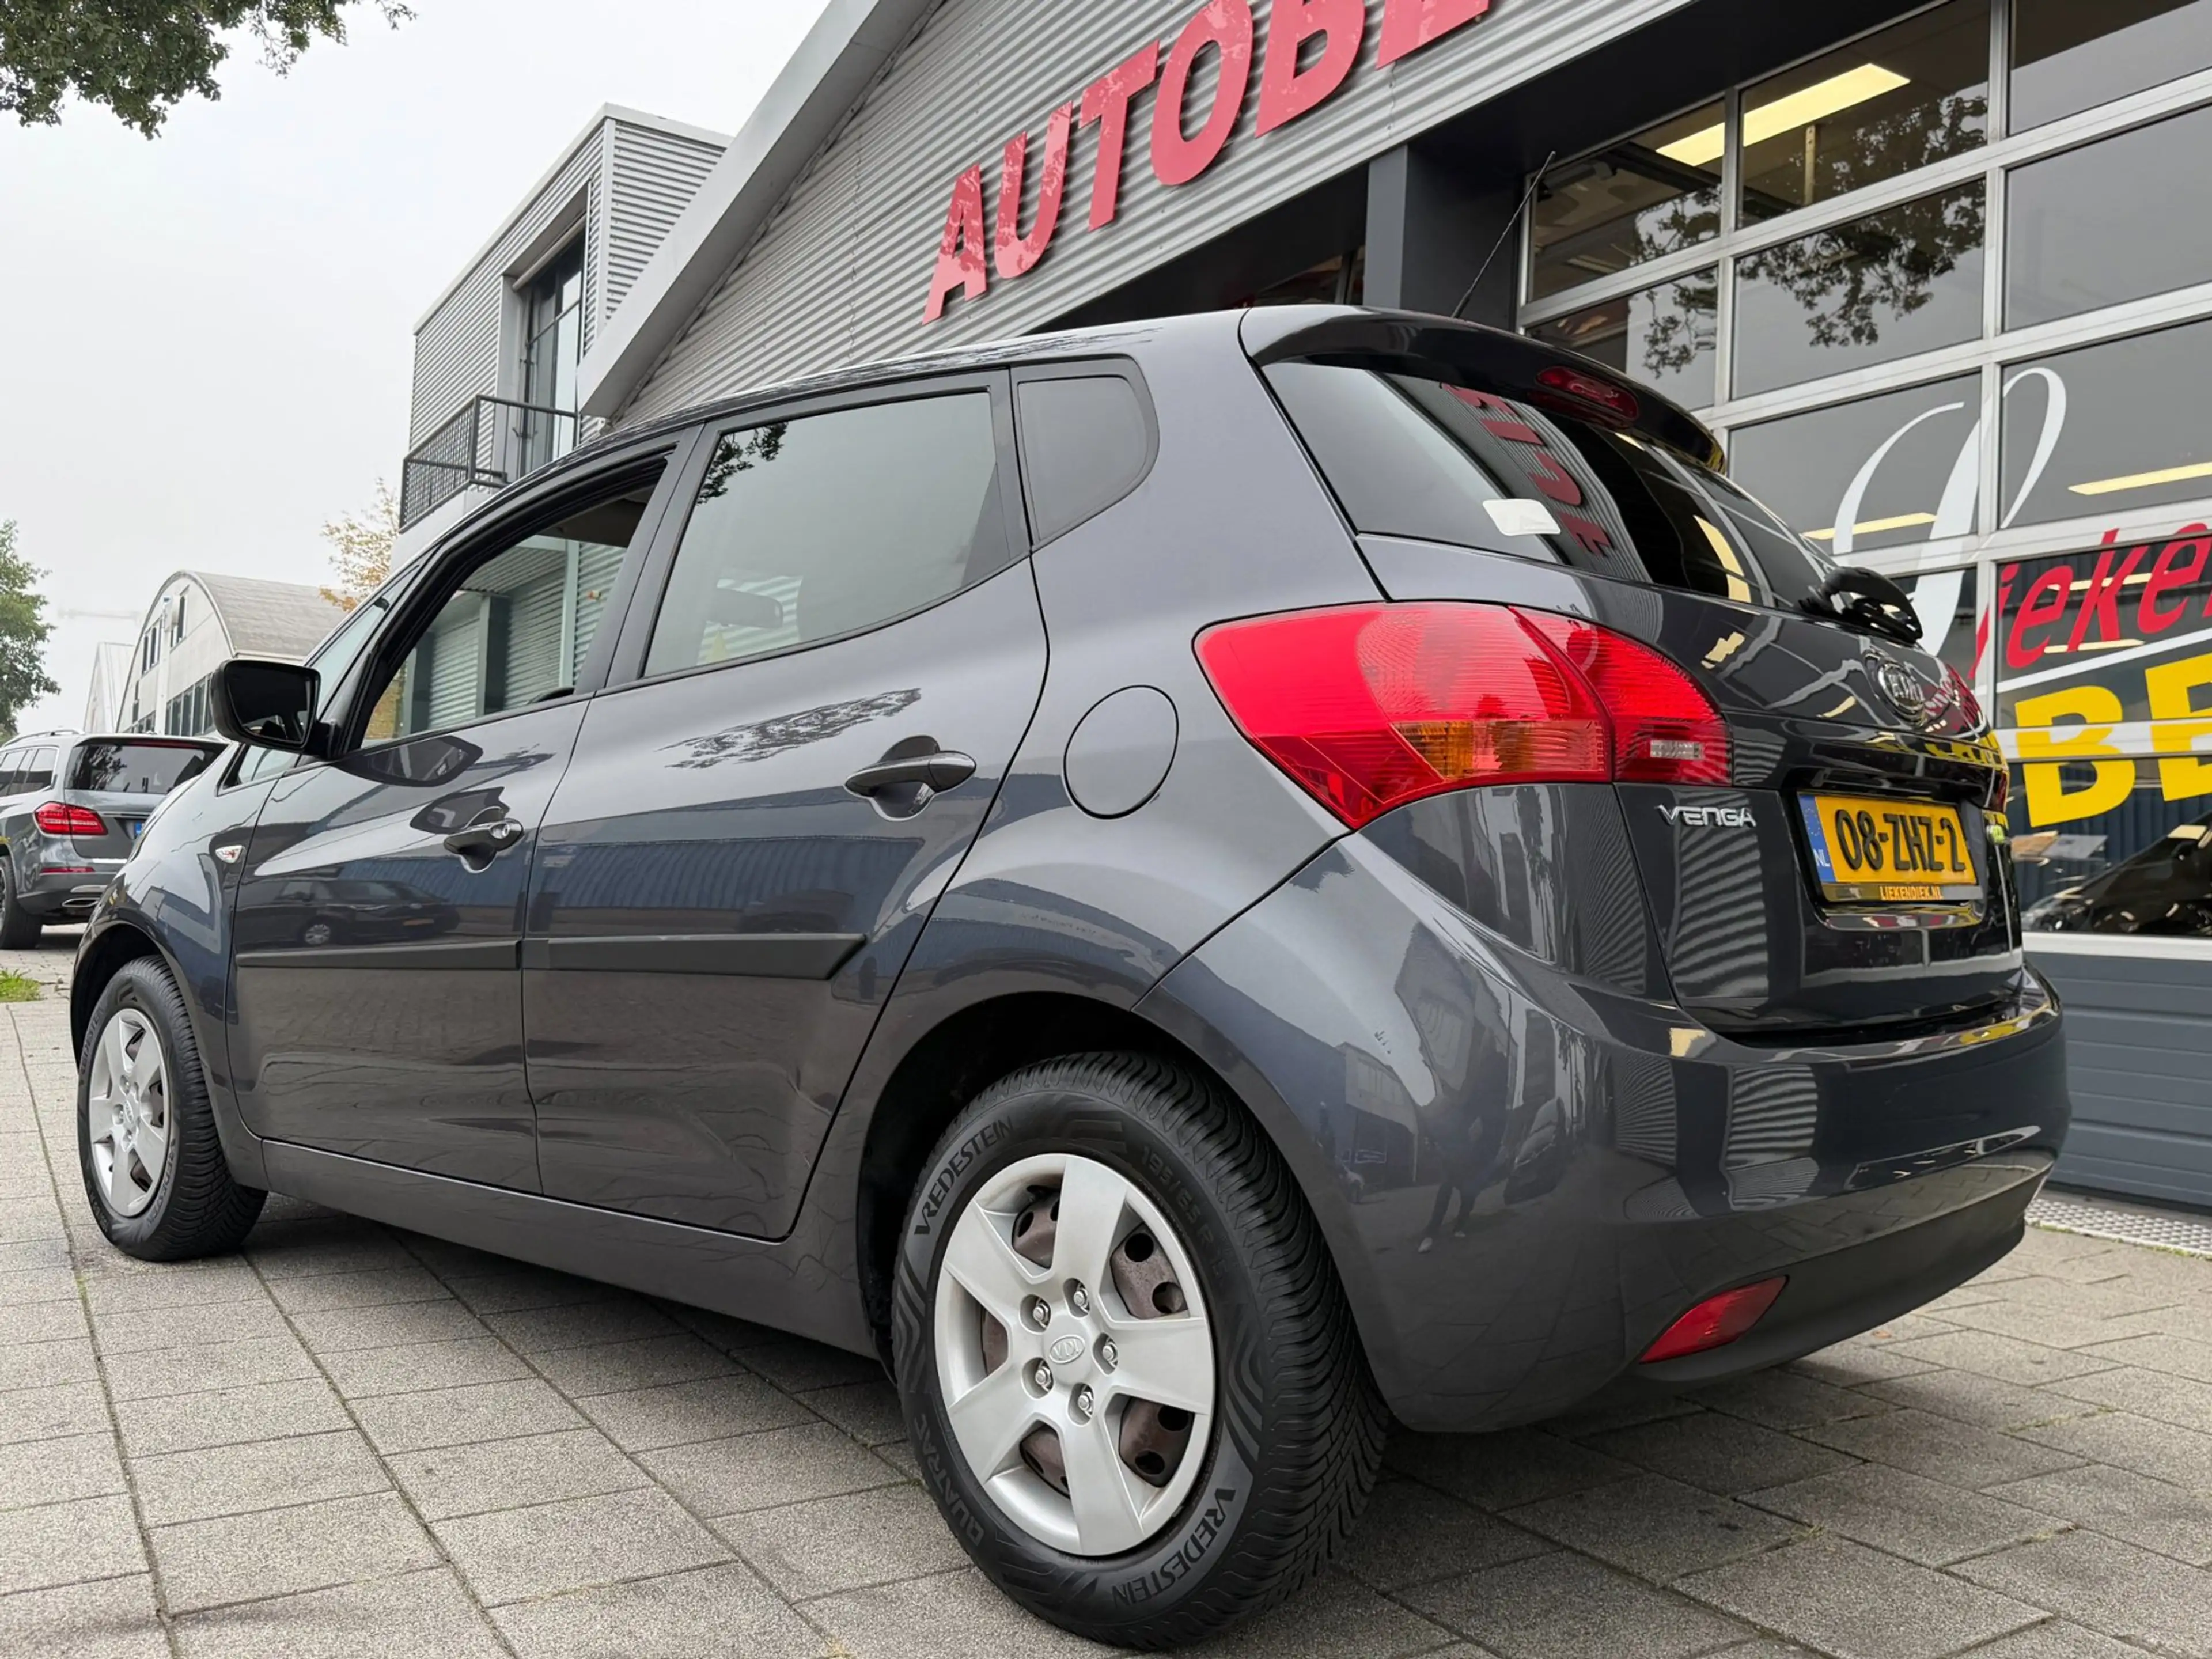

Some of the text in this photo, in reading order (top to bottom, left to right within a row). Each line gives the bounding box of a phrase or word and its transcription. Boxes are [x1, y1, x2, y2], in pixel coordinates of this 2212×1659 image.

[1654, 804, 1756, 827] VENGA
[1835, 809, 1965, 872] 08-ZHZ-2
[1813, 849, 1830, 867] NL
[1879, 885, 1944, 900] LIEKENDIEK.NL
[914, 1115, 1013, 1235] VREDESTEIN
[913, 1413, 984, 1546] QUATRAC
[1111, 1488, 1236, 1609] VREDESTEIN
